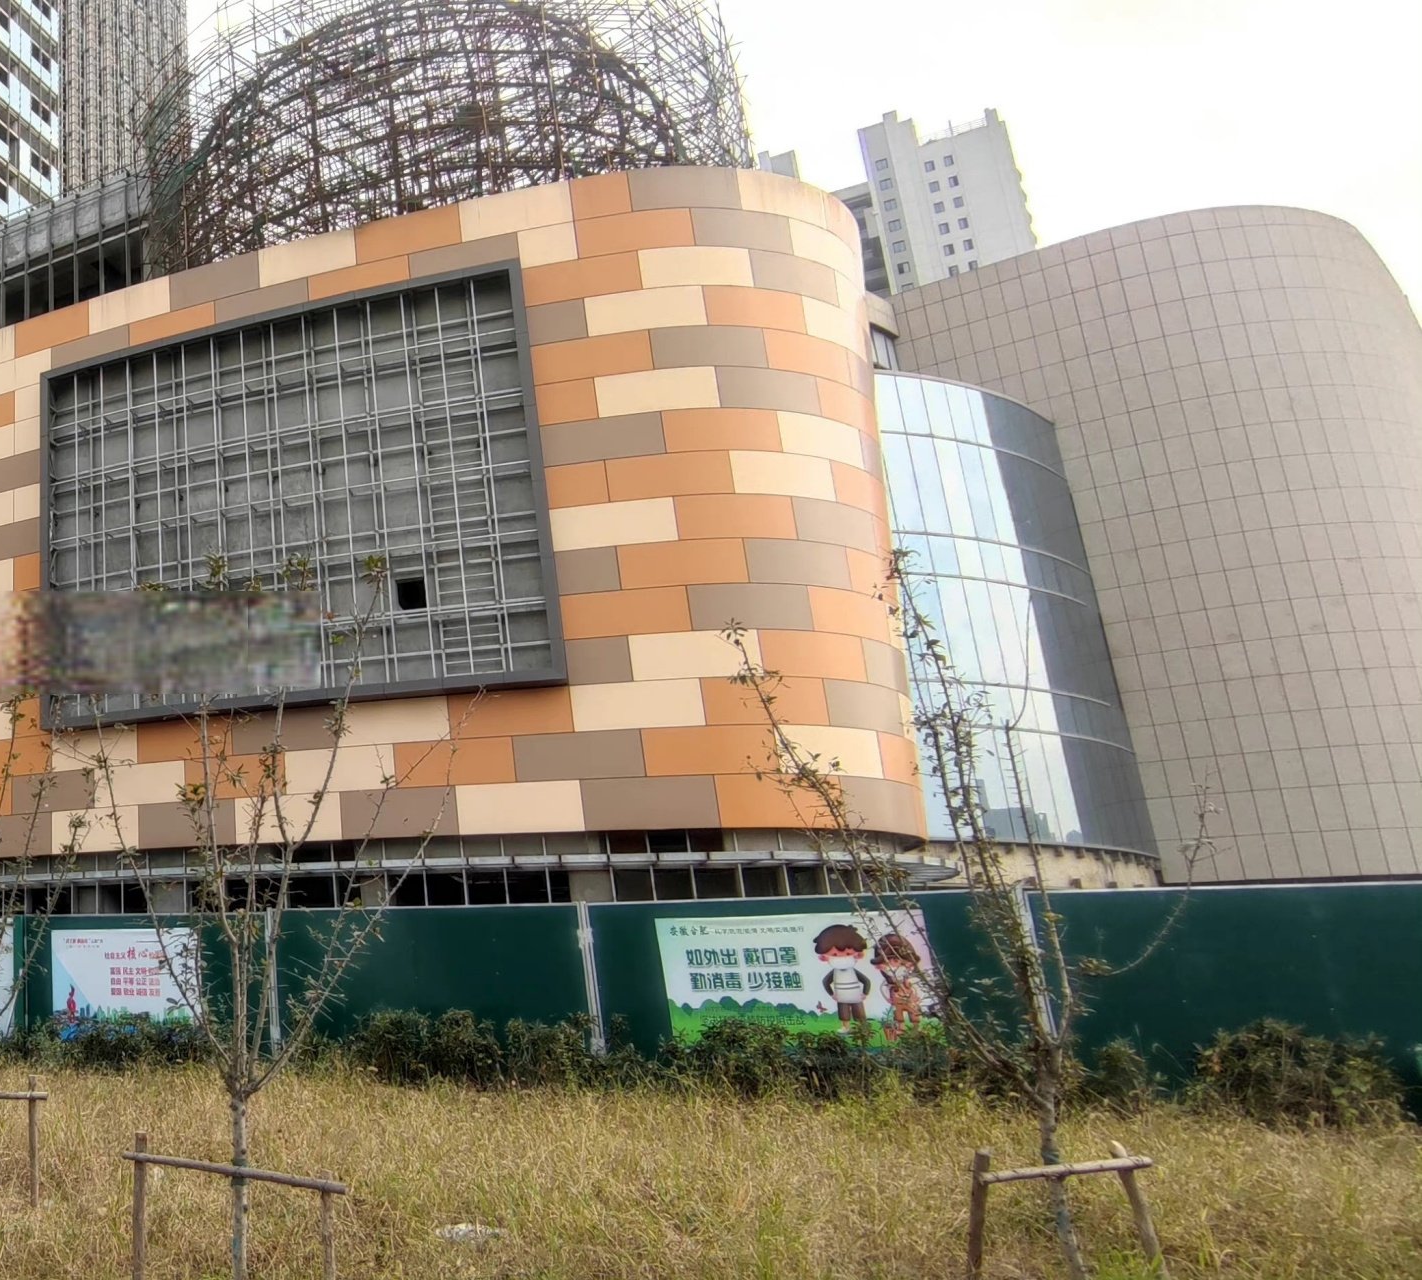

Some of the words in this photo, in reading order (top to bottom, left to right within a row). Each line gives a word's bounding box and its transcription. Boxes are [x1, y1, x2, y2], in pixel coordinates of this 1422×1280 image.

[685, 948, 739, 967] 如外出
[742, 946, 798, 966] 戴口罩
[689, 972, 742, 991] 勤消毒
[747, 970, 803, 990] 少接触
